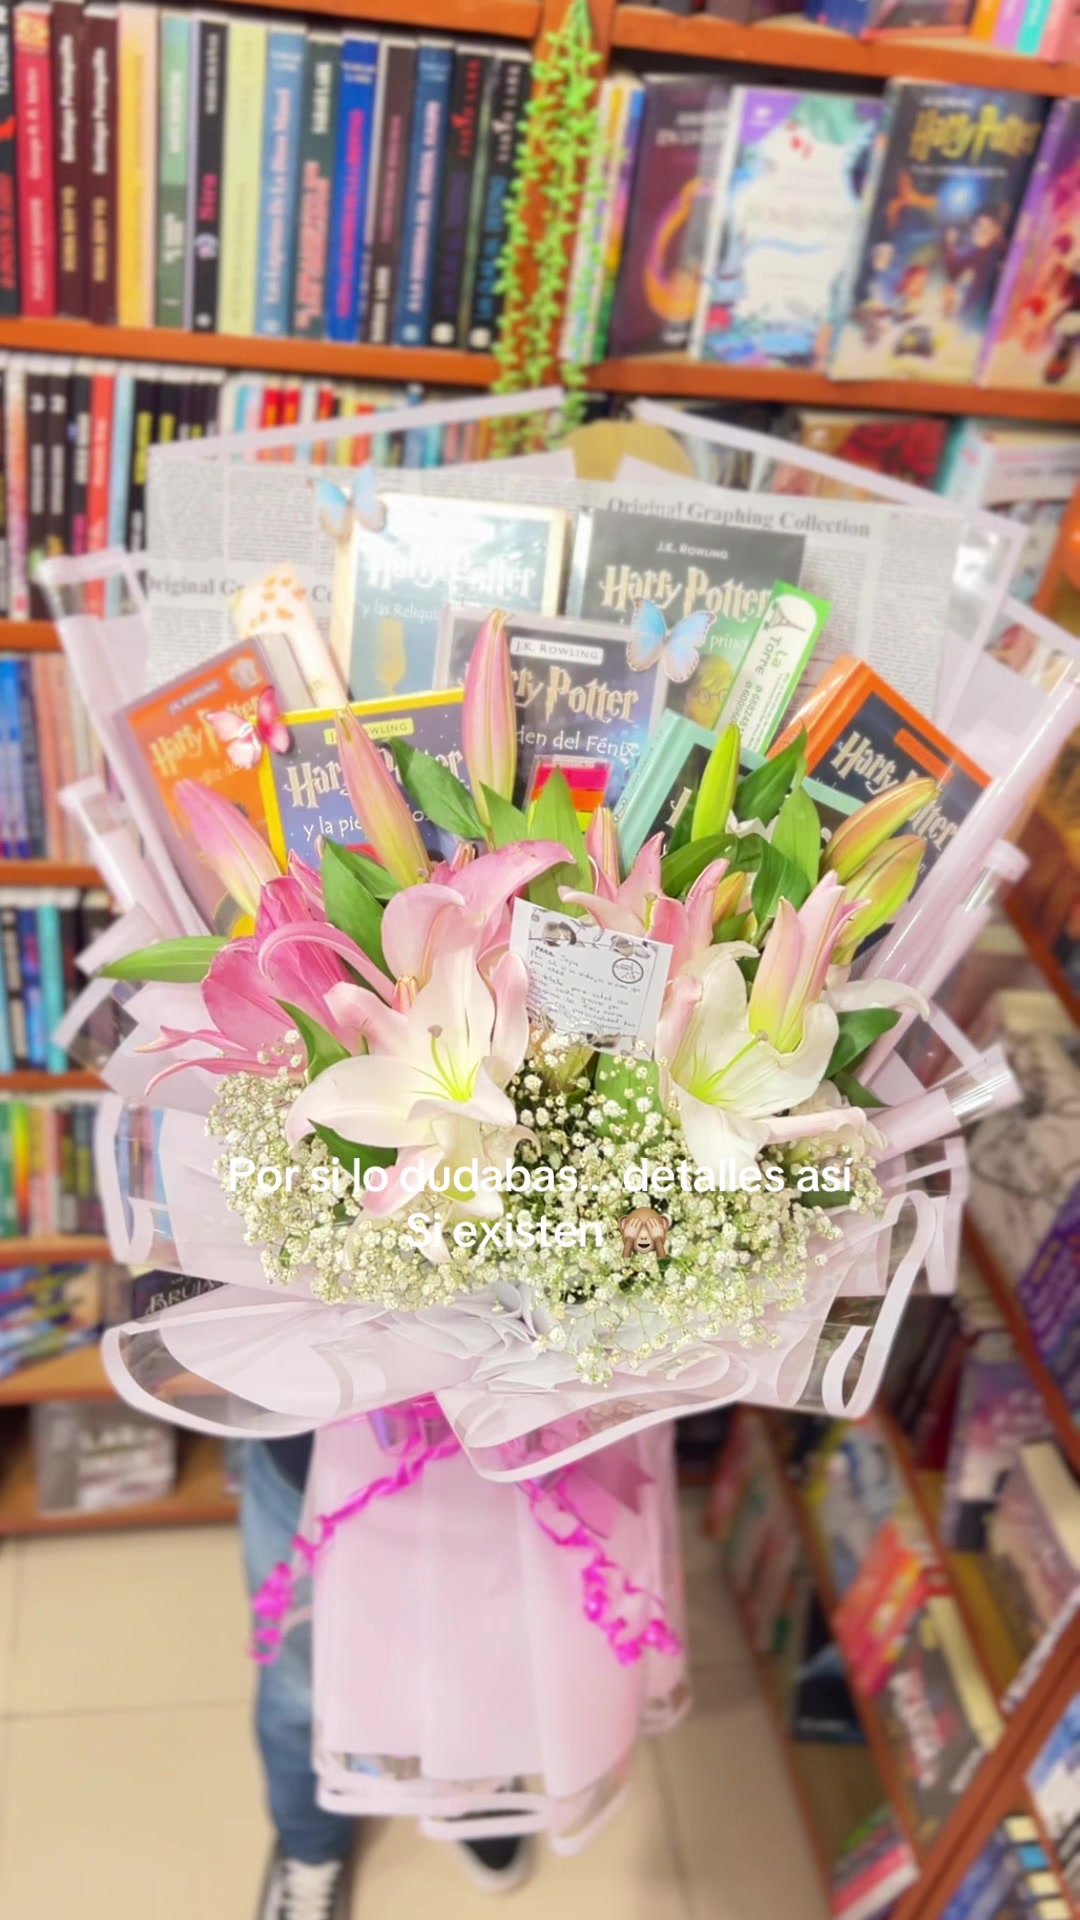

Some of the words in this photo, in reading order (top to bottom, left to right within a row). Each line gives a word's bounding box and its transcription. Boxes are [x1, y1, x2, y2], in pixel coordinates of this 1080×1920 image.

[607, 496, 682, 516] Original
[688, 501, 775, 529] Graphing
[779, 510, 871, 538] Collection
[599, 564, 683, 612] Harry
[683, 565, 773, 622] Potter
[514, 638, 535, 653] J.K.
[540, 642, 599, 660] ROWLING
[545, 665, 639, 724] Potter
[151, 723, 204, 777] Harry
[368, 723, 408, 735] WLING
[553, 730, 581, 751] del
[830, 731, 899, 796] Harry
[304, 824, 314, 842] y
[318, 816, 334, 835] la
